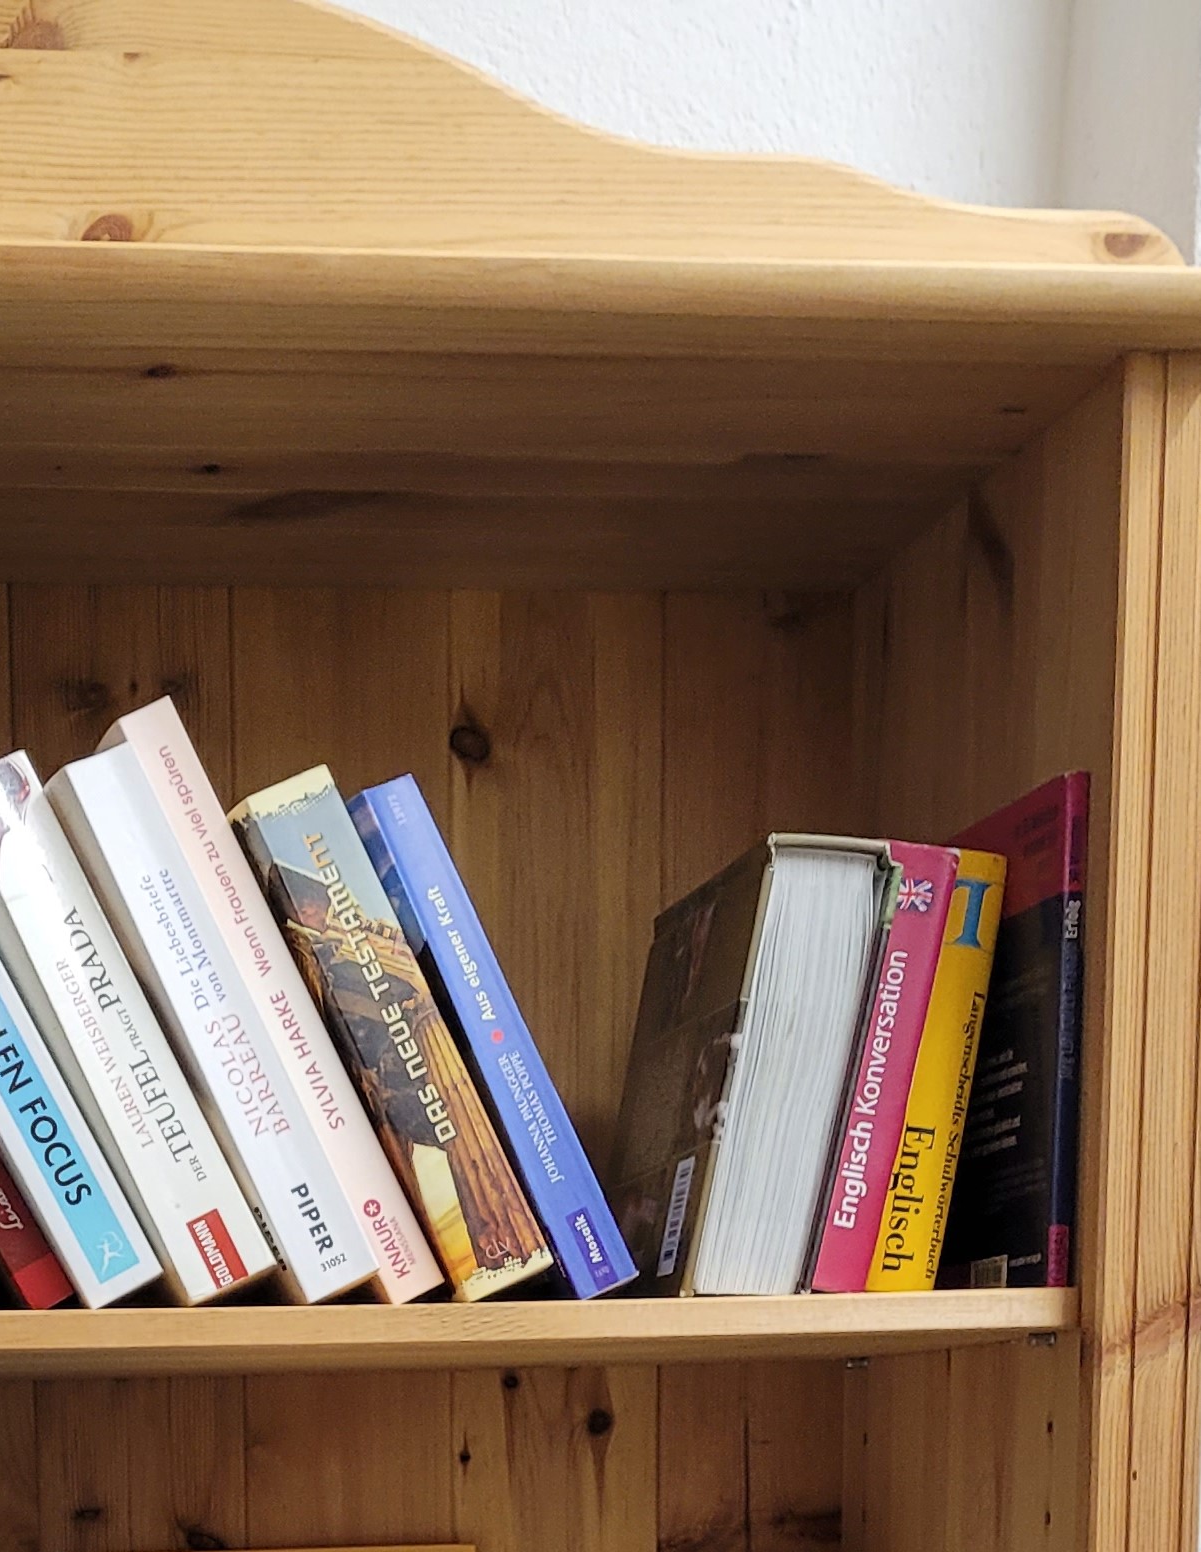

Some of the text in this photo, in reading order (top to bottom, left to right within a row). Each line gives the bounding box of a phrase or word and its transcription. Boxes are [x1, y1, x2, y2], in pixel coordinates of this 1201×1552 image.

[135, 872, 210, 1011] Die Liebesbriefe
[154, 866, 227, 1004] von Montmartre
[154, 741, 347, 1131] SYLVIA HARKE Wenn Frauen zu viel spüren
[423, 884, 497, 1023] Aus eigener Kraft
[53, 956, 154, 1148] LAUREN WEISBERGER
[56, 904, 208, 1183] DER TEUFEL TRÄGT PRADA
[203, 1011, 290, 1136] NICOLAS BARREAU
[379, 1002, 429, 1080] NEUE
[830, 948, 909, 1230] Englisch Konversation
[16, 1096, 95, 1208] FOCUS
[416, 1082, 458, 1144] DAS
[192, 1217, 235, 1288] GOLDMANN
[288, 1181, 336, 1254] PIPER
[368, 1214, 413, 1280] KNAUR
[570, 1213, 604, 1264] Mosaik
[875, 1121, 935, 1276] Englisch
[318, 1251, 347, 1273] 31052
